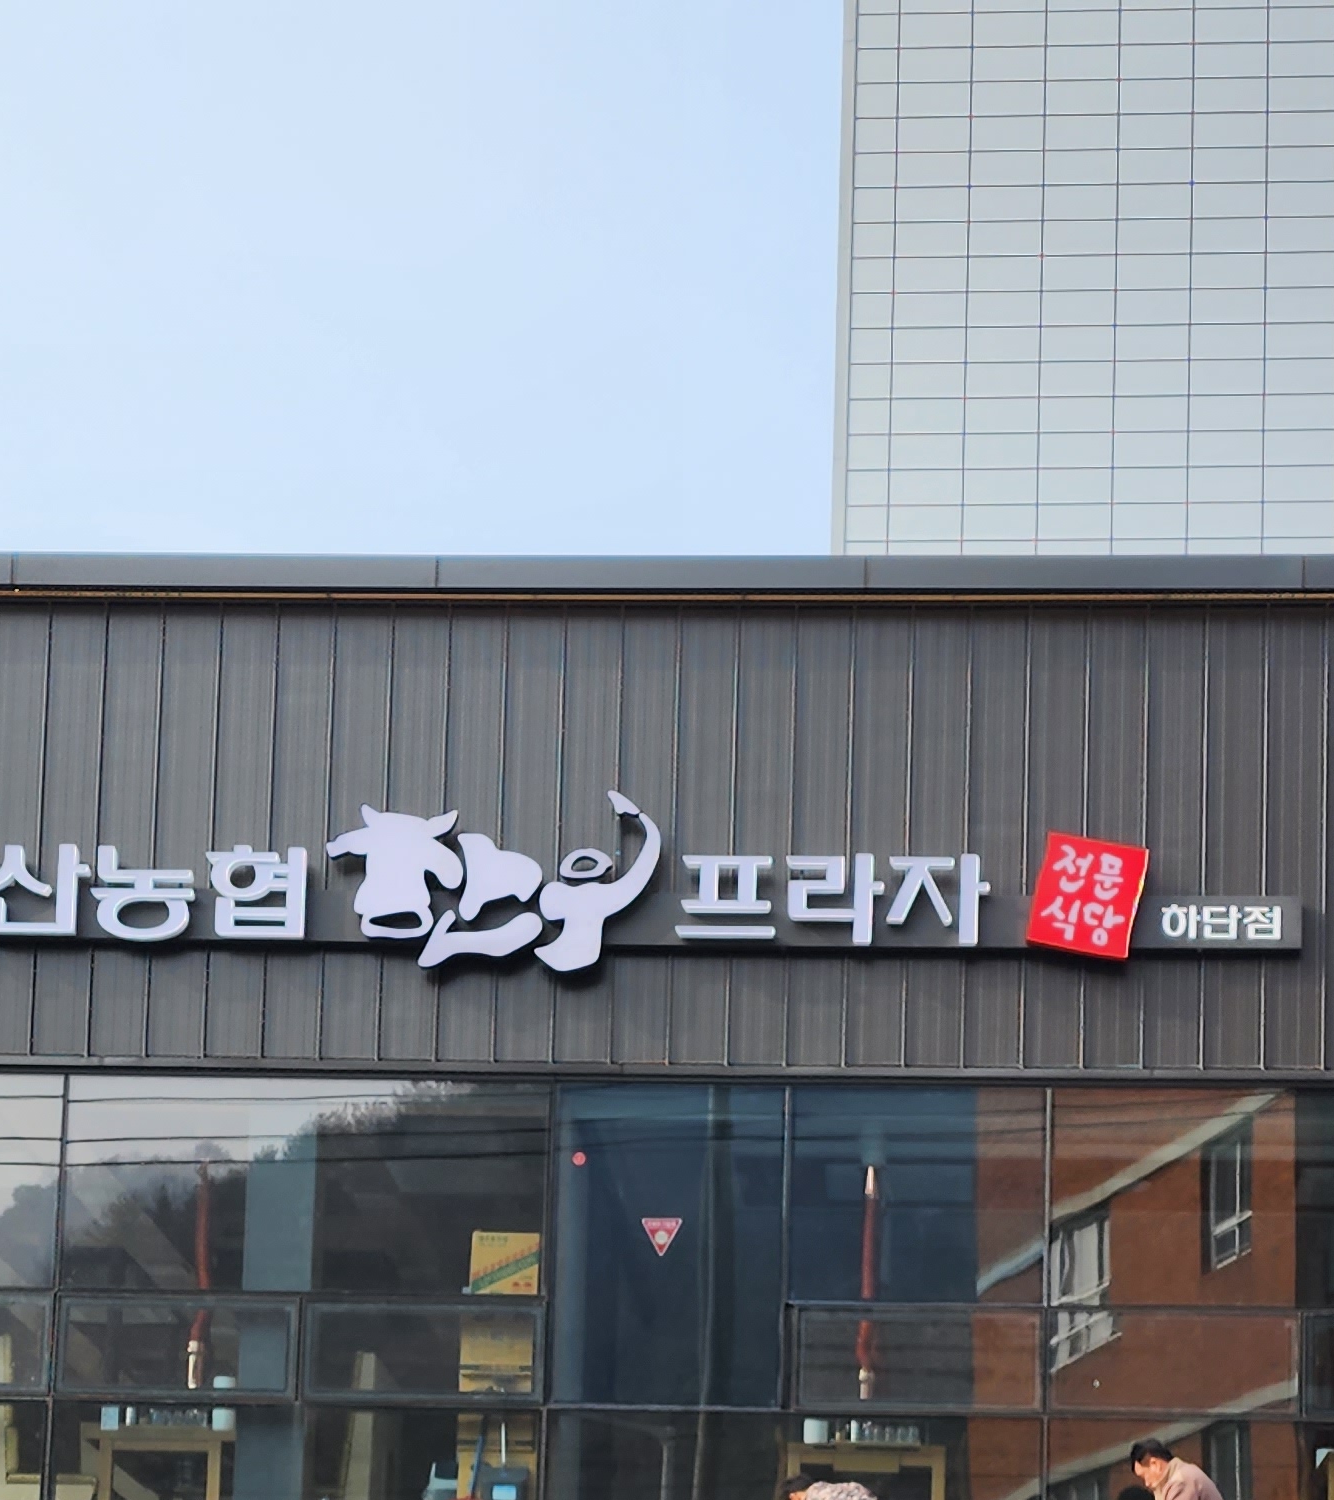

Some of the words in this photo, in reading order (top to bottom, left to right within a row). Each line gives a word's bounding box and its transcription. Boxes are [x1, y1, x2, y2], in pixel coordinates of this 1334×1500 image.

[1053, 844, 1124, 900] 전문
[675, 852, 991, 947] 프라자
[1040, 896, 1124, 947] 식당
[1161, 903, 1283, 941] 하단점
